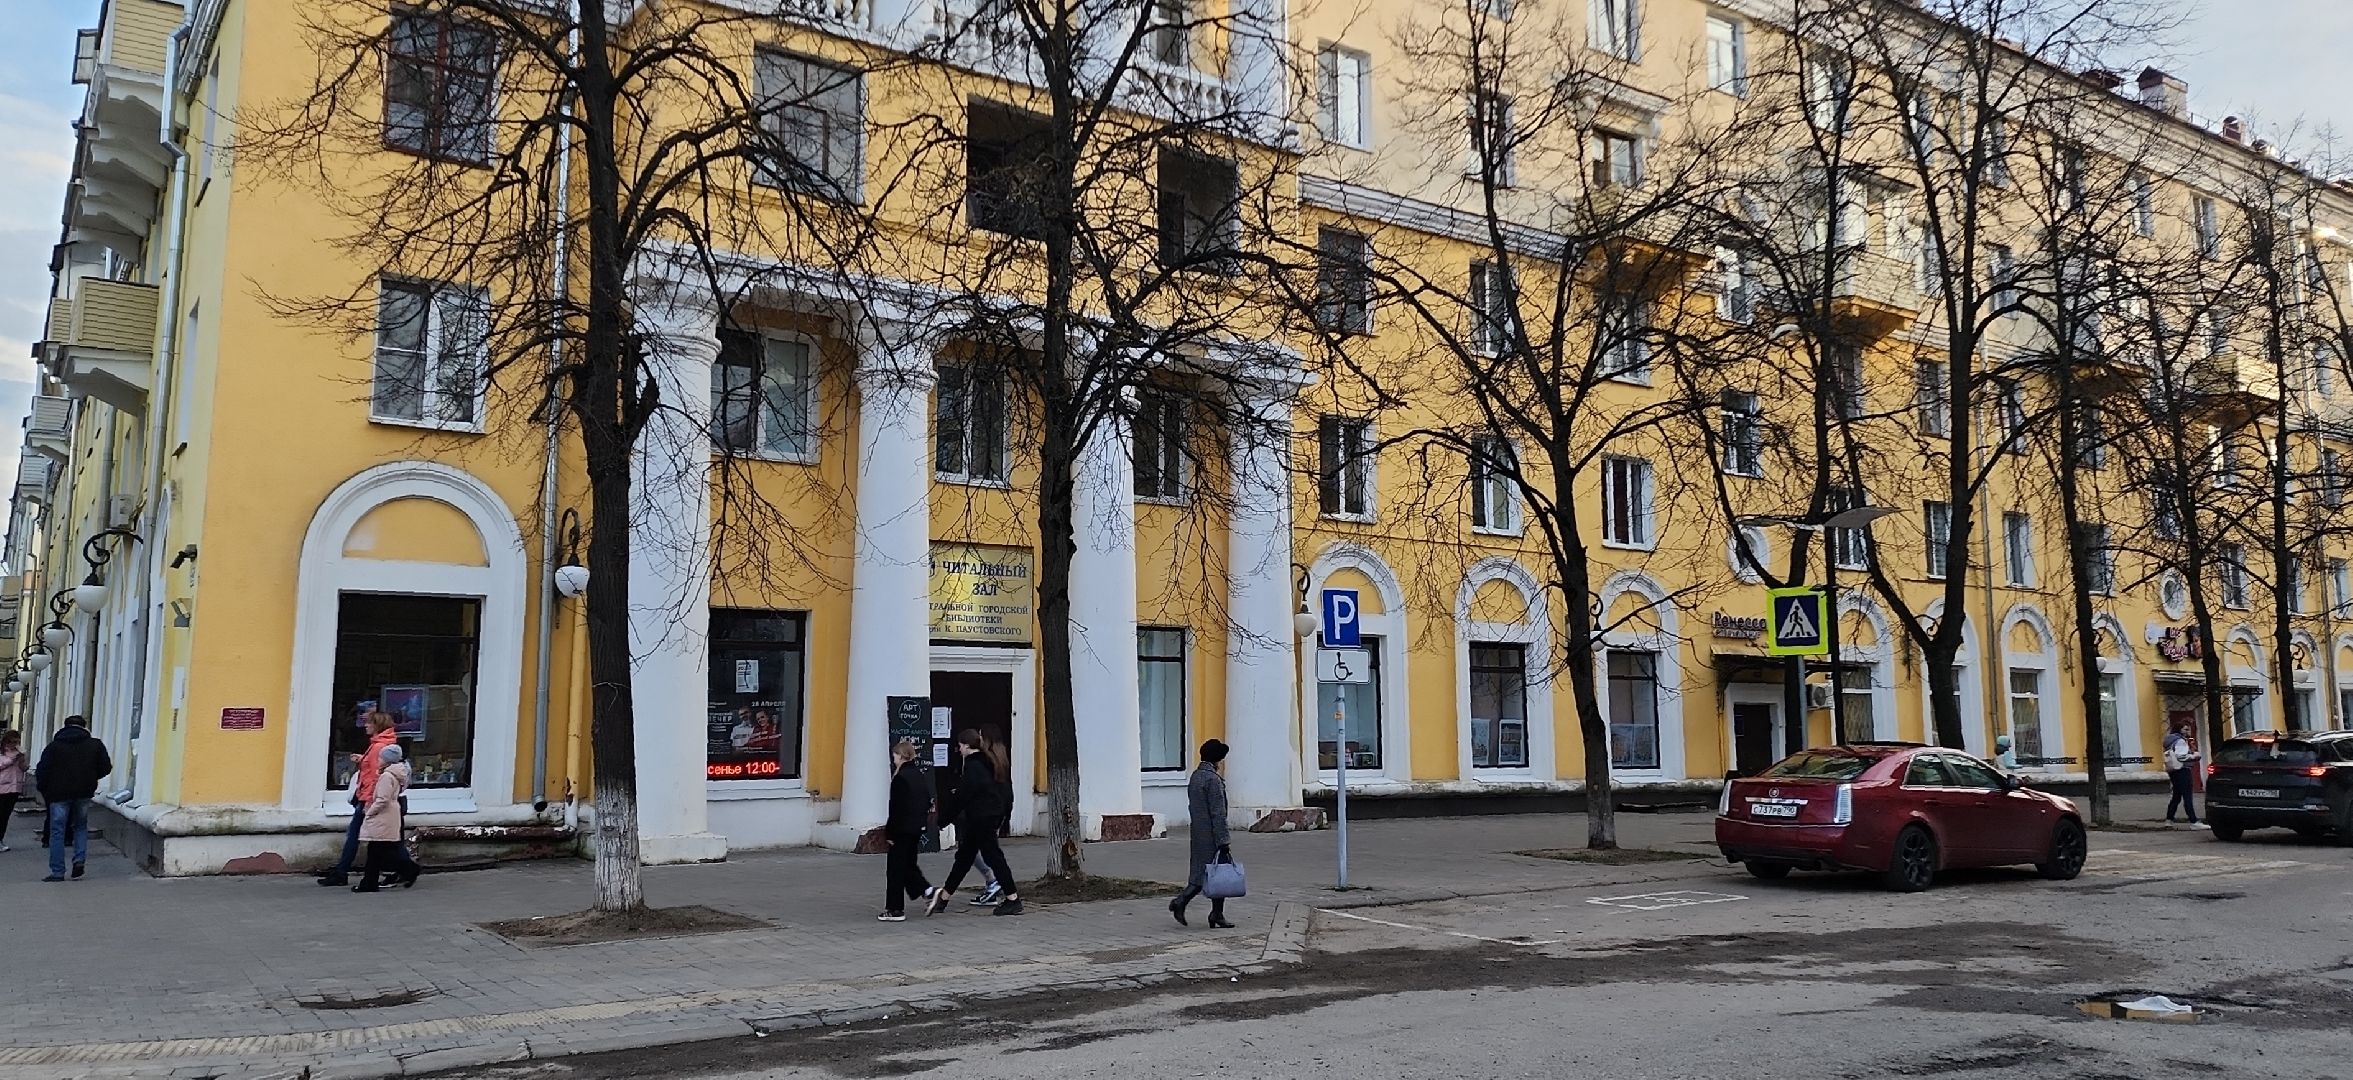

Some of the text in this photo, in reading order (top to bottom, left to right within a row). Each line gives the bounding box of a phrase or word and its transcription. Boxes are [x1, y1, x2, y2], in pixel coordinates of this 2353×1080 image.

[943, 561, 1027, 578] ЧИТАЛЬНЫЙ
[972, 582, 998, 596] ЗАЛ
[979, 604, 1029, 616] ГОРОДСКОЙ
[946, 613, 1003, 625] БИБЛИОТЕКИ
[1332, 594, 1356, 640] P
[956, 625, 1022, 636] ПАУСТОВСКОГО
